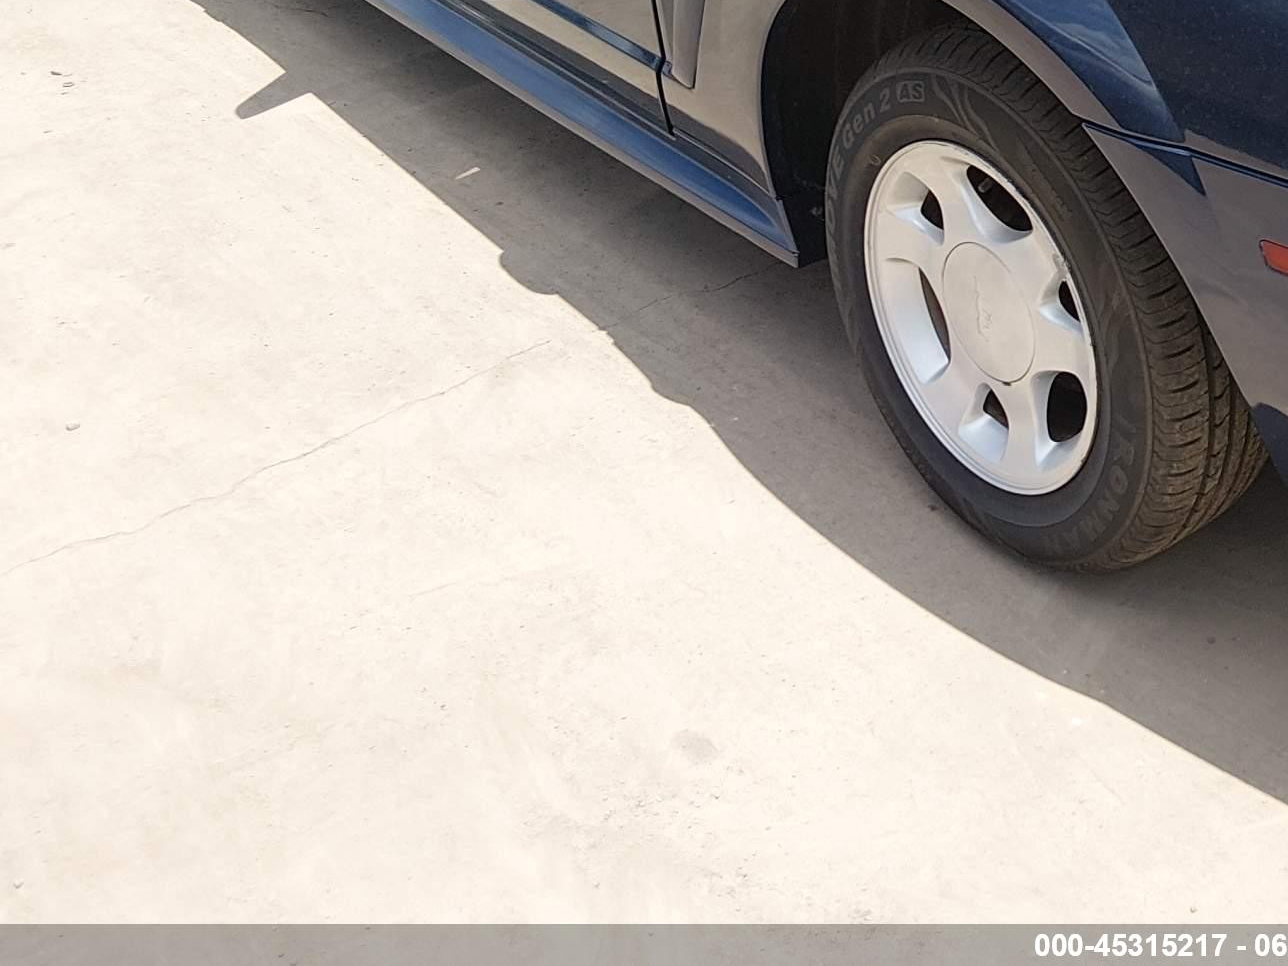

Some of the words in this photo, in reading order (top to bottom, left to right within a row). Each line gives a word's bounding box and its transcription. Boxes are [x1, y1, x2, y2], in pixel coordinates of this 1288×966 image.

[842, 101, 876, 150] Gen
[879, 87, 892, 113] 2
[897, 81, 925, 103] AS
